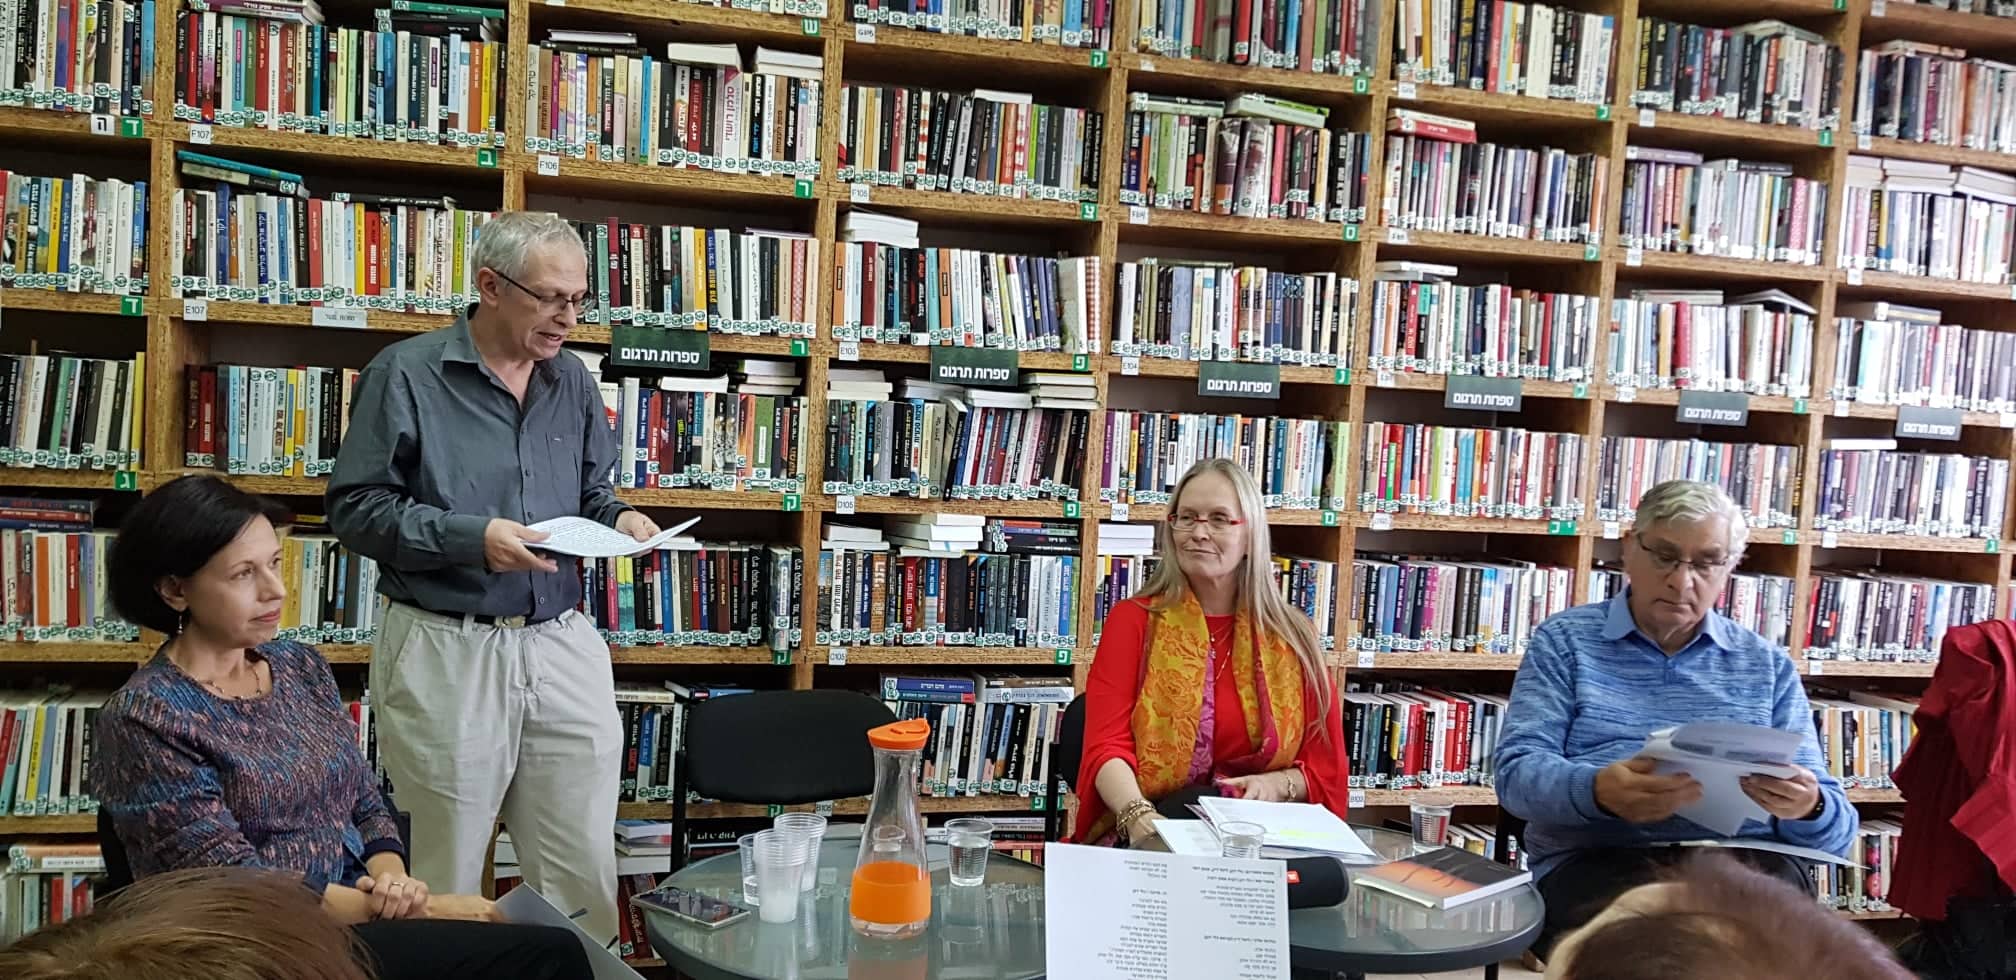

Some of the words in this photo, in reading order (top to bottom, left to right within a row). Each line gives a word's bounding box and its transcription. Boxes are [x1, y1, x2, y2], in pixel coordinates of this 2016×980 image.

[803, 19, 818, 33] ש
[1093, 51, 1104, 66] ק
[97, 117, 107, 131] ה
[125, 119, 139, 135] ד
[191, 129, 210, 140] F107
[480, 151, 493, 166] ב
[539, 160, 557, 170] F106
[798, 182, 809, 195] ר
[125, 300, 139, 315] ד
[185, 306, 204, 315] E107
[794, 341, 805, 354] ר
[621, 347, 657, 362] תרגום
[660, 349, 700, 364] ספרות
[1075, 356, 1084, 369] פ
[939, 365, 972, 379] תרגום
[974, 366, 1010, 380] ספרות
[1207, 379, 1237, 392] תרגום
[1239, 380, 1272, 393] ספרות
[1483, 394, 1515, 407] ספרות
[120, 472, 131, 488] ג
[787, 496, 797, 510] ק
[838, 500, 854, 509] D105
[1067, 503, 1076, 517] פ
[1112, 508, 1127, 517] D104
[830, 653, 845, 662] C105
[1059, 650, 1069, 663] פ
[1034, 797, 1044, 808] פ
